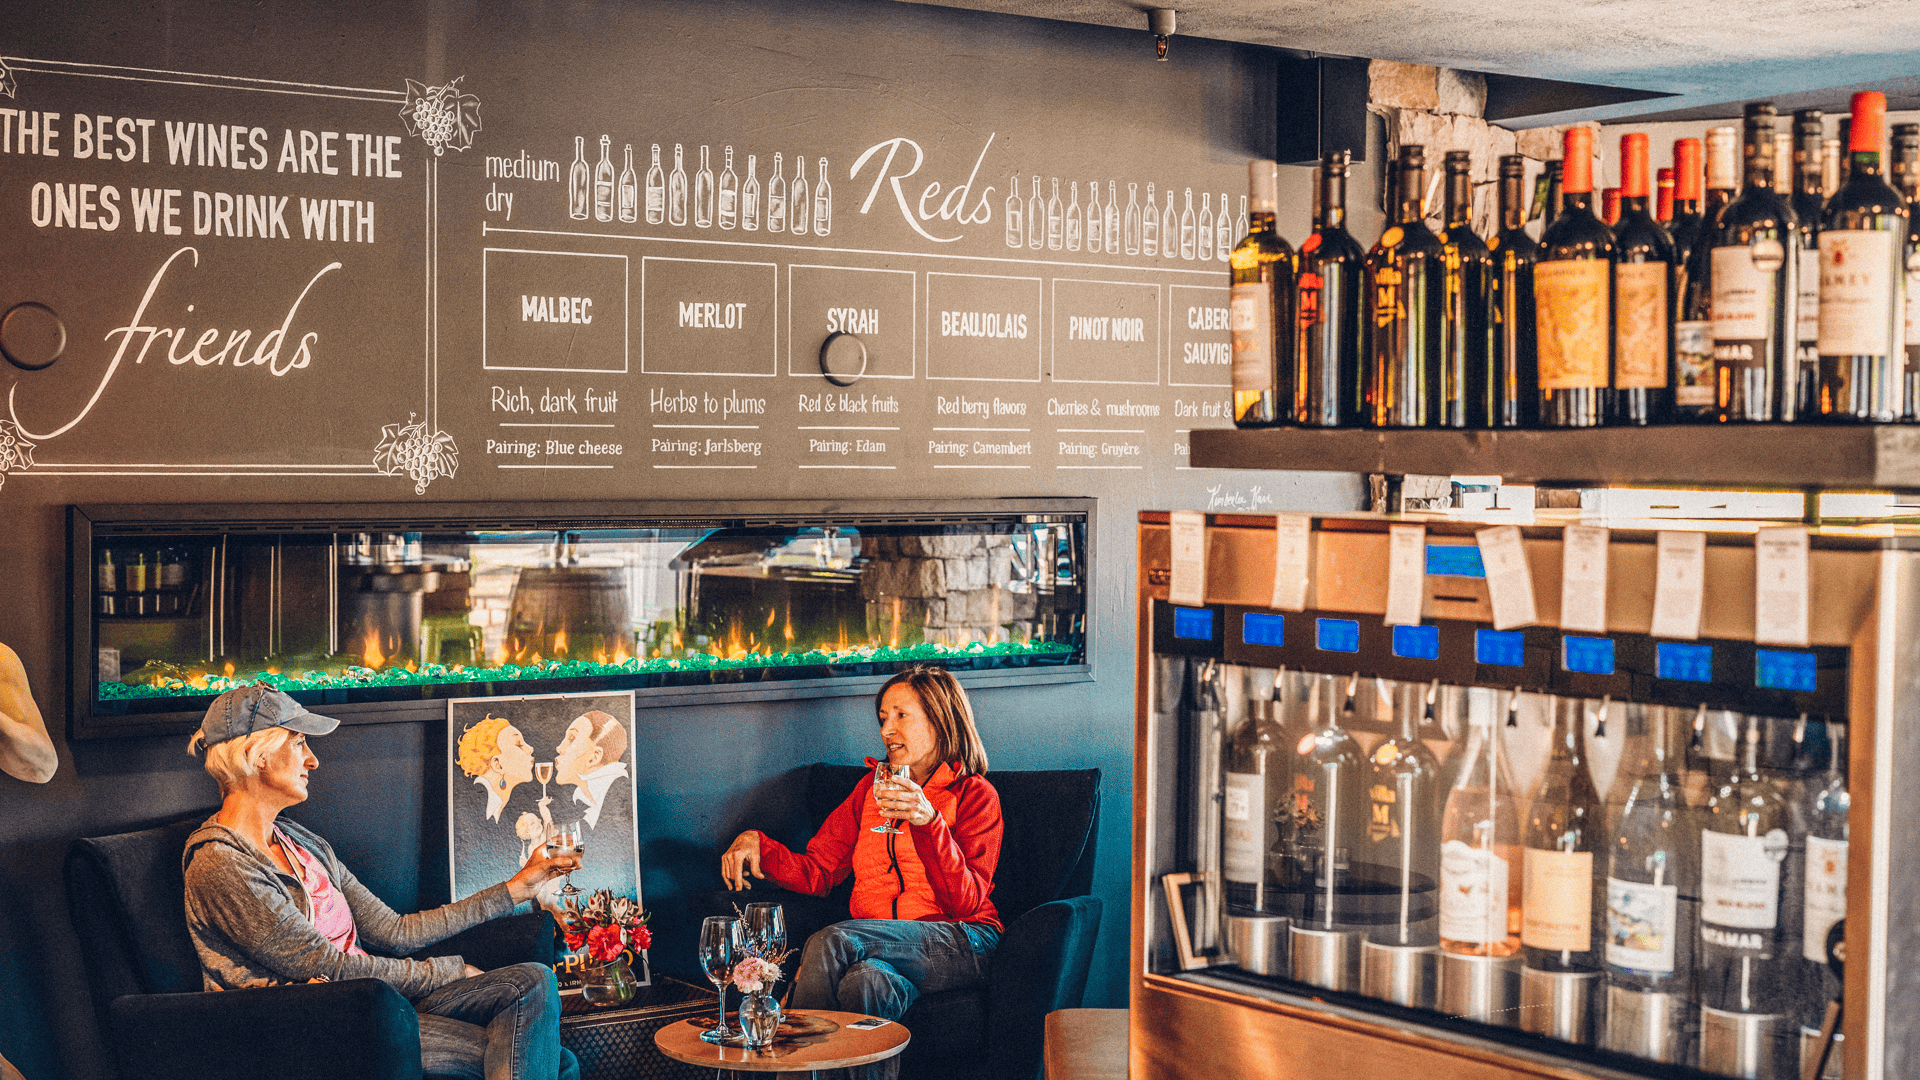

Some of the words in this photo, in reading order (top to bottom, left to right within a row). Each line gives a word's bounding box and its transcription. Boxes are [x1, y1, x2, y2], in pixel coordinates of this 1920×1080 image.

[0, 108, 60, 157] THE
[73, 113, 156, 163] BEST
[164, 121, 268, 170] WINES
[277, 129, 339, 176] ARE
[345, 133, 402, 178] THE
[485, 150, 560, 183] medium
[850, 132, 995, 242] Reds
[31, 182, 120, 231] ONES
[131, 187, 182, 236] WE
[193, 191, 290, 239] DRINK
[300, 197, 374, 243] WITH
[485, 182, 514, 221] dry
[521, 295, 592, 325] MALBEC
[679, 301, 747, 329] MERLOT
[827, 307, 878, 334] SYRAH
[1188, 307, 1232, 331] CABER
[942, 311, 1027, 339] BEAUJOLAIS
[1070, 316, 1109, 340] PINOT
[1112, 318, 1144, 341] NOIR
[7, 246, 343, 440] friends
[491, 386, 534, 414] Rich,
[540, 387, 578, 414] dark
[584, 387, 618, 413] fruit
[650, 387, 697, 413] Herbs
[704, 392, 718, 413] to
[723, 389, 766, 420] plums
[798, 393, 821, 412] Red
[825, 394, 836, 412] &
[839, 393, 867, 413] black
[872, 395, 899, 413] fruits
[937, 396, 959, 414] Red
[962, 396, 989, 419] berry
[993, 397, 1026, 415] flavors
[1048, 398, 1088, 415] Cherries
[1091, 399, 1100, 415] &
[1106, 400, 1160, 416] mushrooms
[1175, 399, 1198, 417] Dark
[1202, 401, 1221, 417] fruit
[1223, 400, 1233, 419] &
[486, 439, 540, 458] Pairing:
[545, 440, 575, 455] Blue
[578, 440, 623, 455] cheese
[652, 439, 701, 456] Pairing:
[704, 439, 762, 456] Jarlsberg
[809, 439, 854, 456] Pairing:
[856, 440, 886, 452] Edam
[928, 441, 968, 457] Pairing:
[973, 441, 1031, 454] Camembert
[1059, 442, 1097, 458] Pairing:
[1102, 443, 1139, 457] Gruyère
